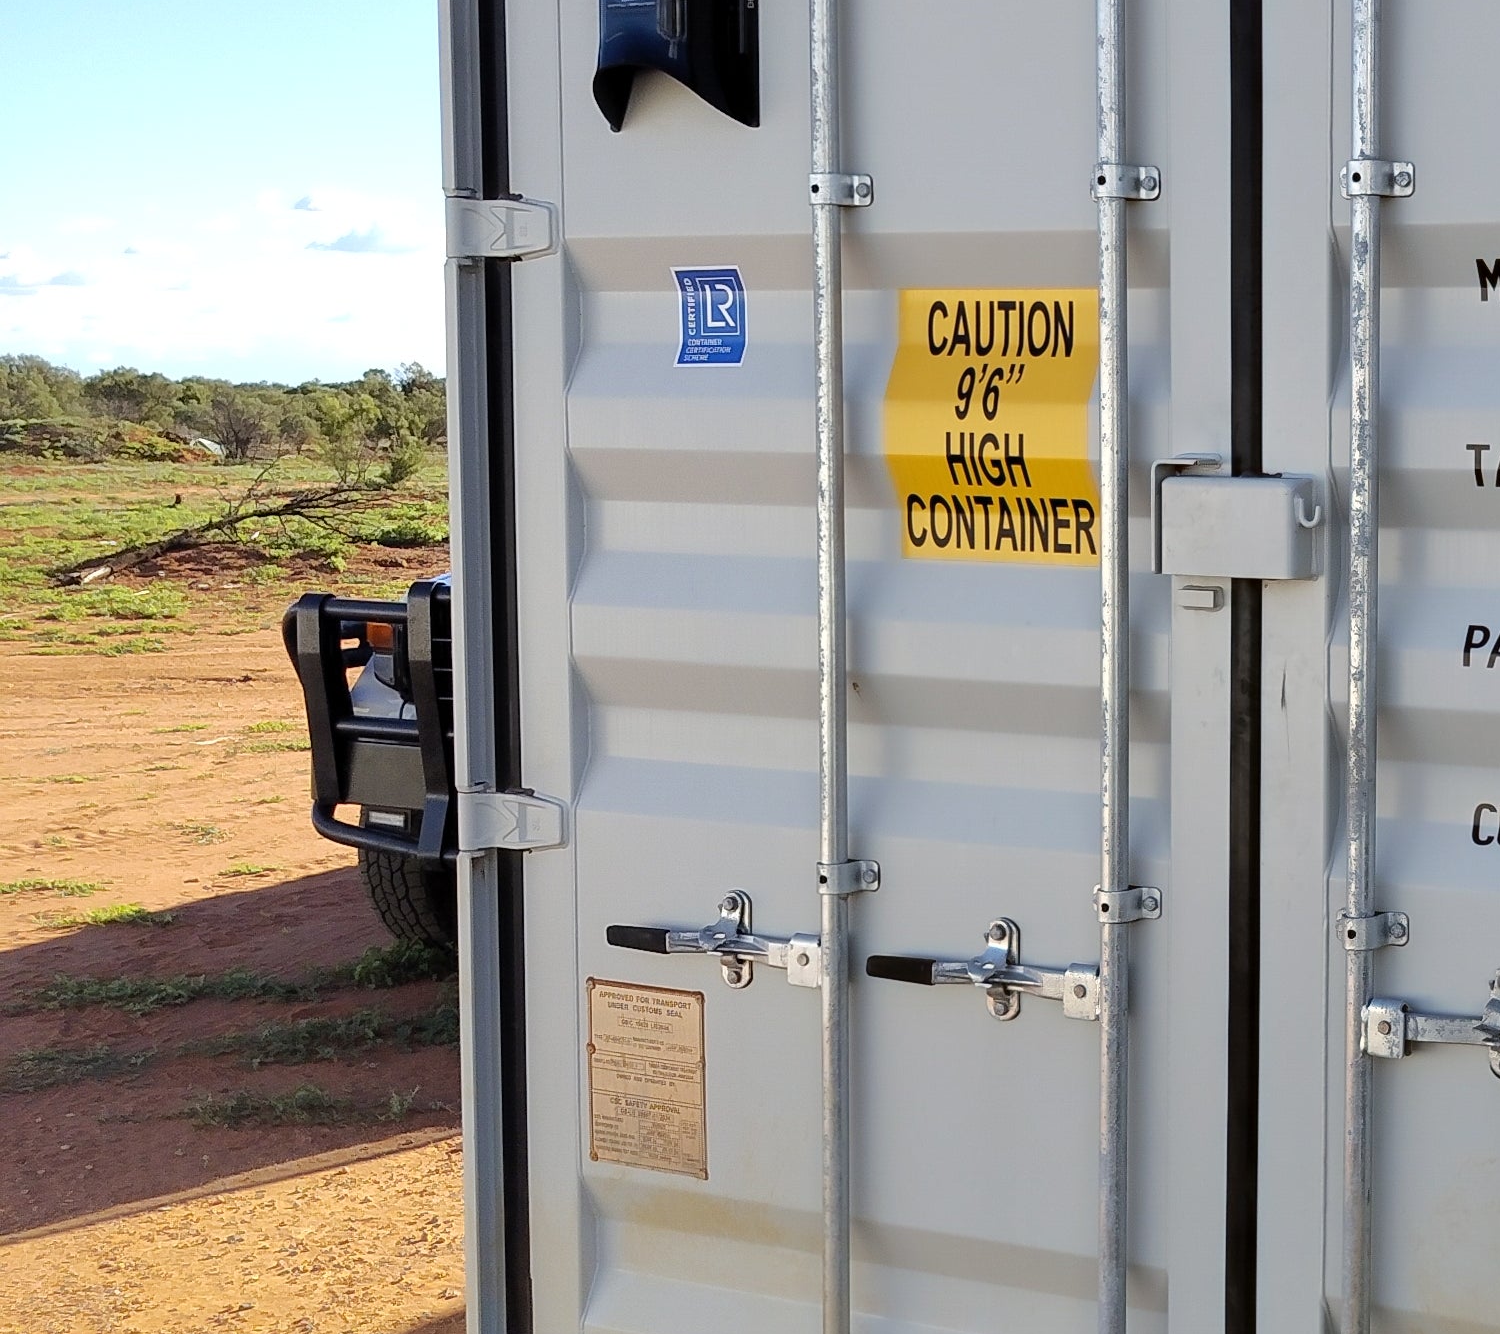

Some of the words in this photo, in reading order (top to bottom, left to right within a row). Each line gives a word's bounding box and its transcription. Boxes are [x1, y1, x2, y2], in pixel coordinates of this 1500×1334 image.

[684, 277, 697, 336] CERTIFIED
[704, 283, 737, 328] LR
[927, 300, 1074, 358] CAUTION
[945, 431, 1032, 488] HIGH
[906, 493, 1097, 556] CONTAINER
[599, 990, 634, 1003] APPROVED
[636, 995, 650, 1005] FOR
[652, 997, 692, 1010] TRANSPORT
[607, 1001, 629, 1011] UNDER
[633, 1004, 663, 1016] CUSTOMS
[666, 1009, 683, 1019] SEAL
[609, 1096, 623, 1106] CSC
[624, 1099, 648, 1109] SAFETY
[649, 1103, 681, 1115] APPROVAL
